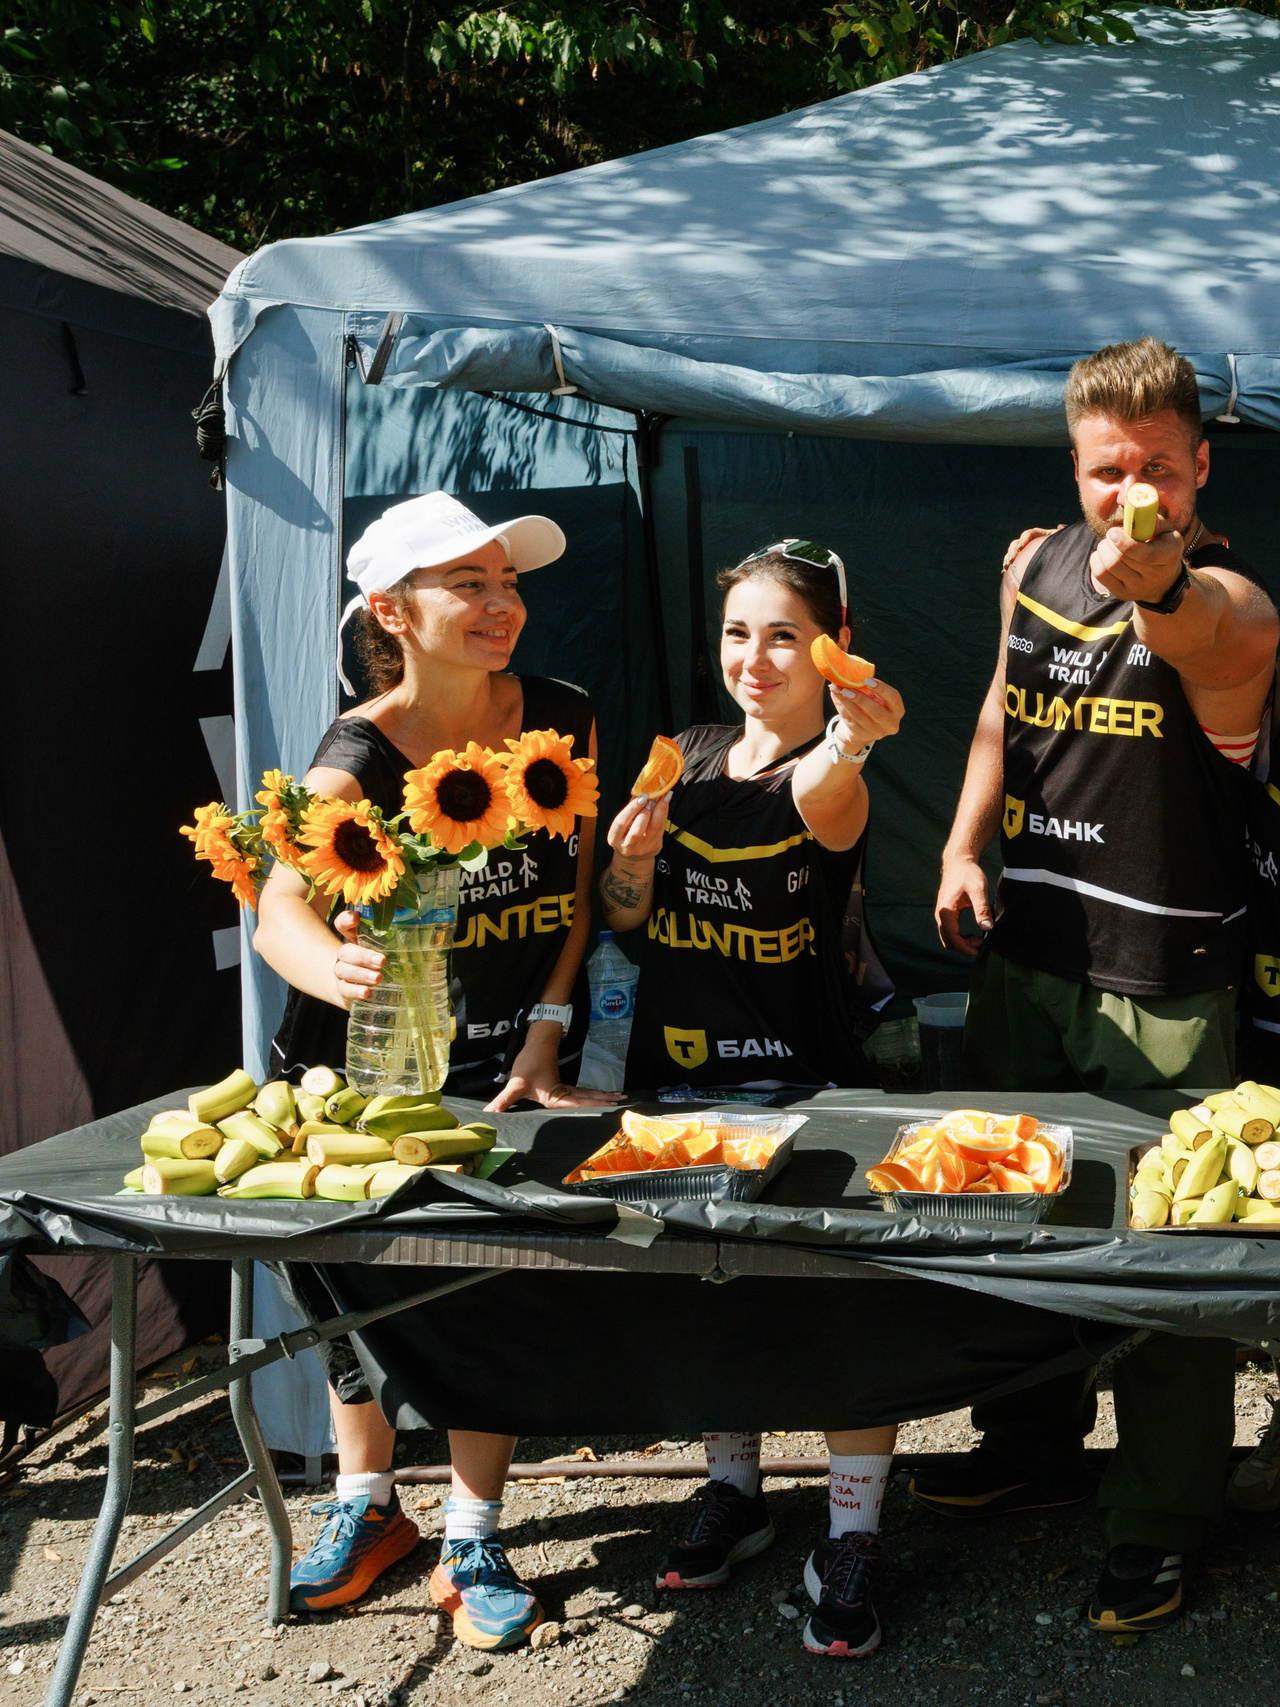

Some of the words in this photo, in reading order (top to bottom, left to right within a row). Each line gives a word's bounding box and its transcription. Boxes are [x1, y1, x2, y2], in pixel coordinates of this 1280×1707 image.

[1052, 646, 1093, 667] WILD
[1048, 663, 1094, 686] TRAIL
[1005, 683, 1164, 738] OLUNTEER
[1029, 813, 1105, 844] БАНК
[459, 879, 519, 905] TRAIL
[686, 868, 729, 892] WILD
[684, 886, 739, 910] TRAIL
[452, 892, 576, 948] UNTEE
[647, 907, 817, 963] VOLUNTEER
[467, 1020, 512, 1040] БА
[717, 1037, 793, 1058] БАН
[830, 1471, 873, 1484] СТЬЕ
